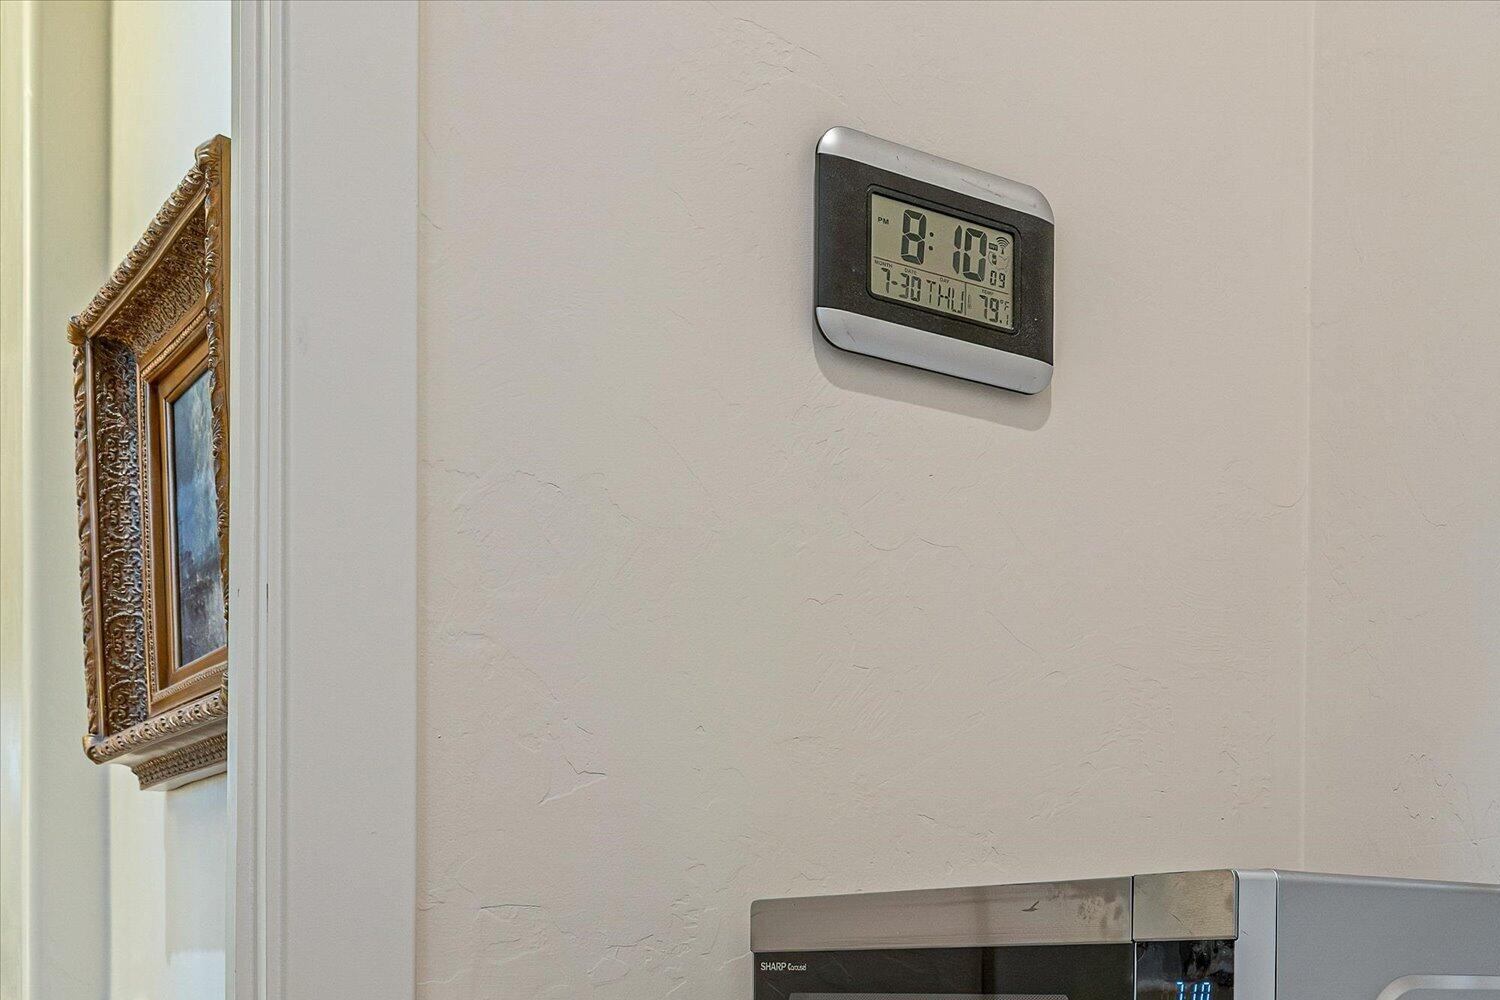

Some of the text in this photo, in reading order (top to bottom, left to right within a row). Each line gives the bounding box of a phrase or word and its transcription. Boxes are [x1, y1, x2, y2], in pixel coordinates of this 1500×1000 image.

[877, 216, 890, 225] PM
[901, 209, 988, 283] 8:10
[874, 259, 893, 269] MONTH
[881, 267, 965, 314] 7-30 THU
[760, 962, 787, 971] SHARP
